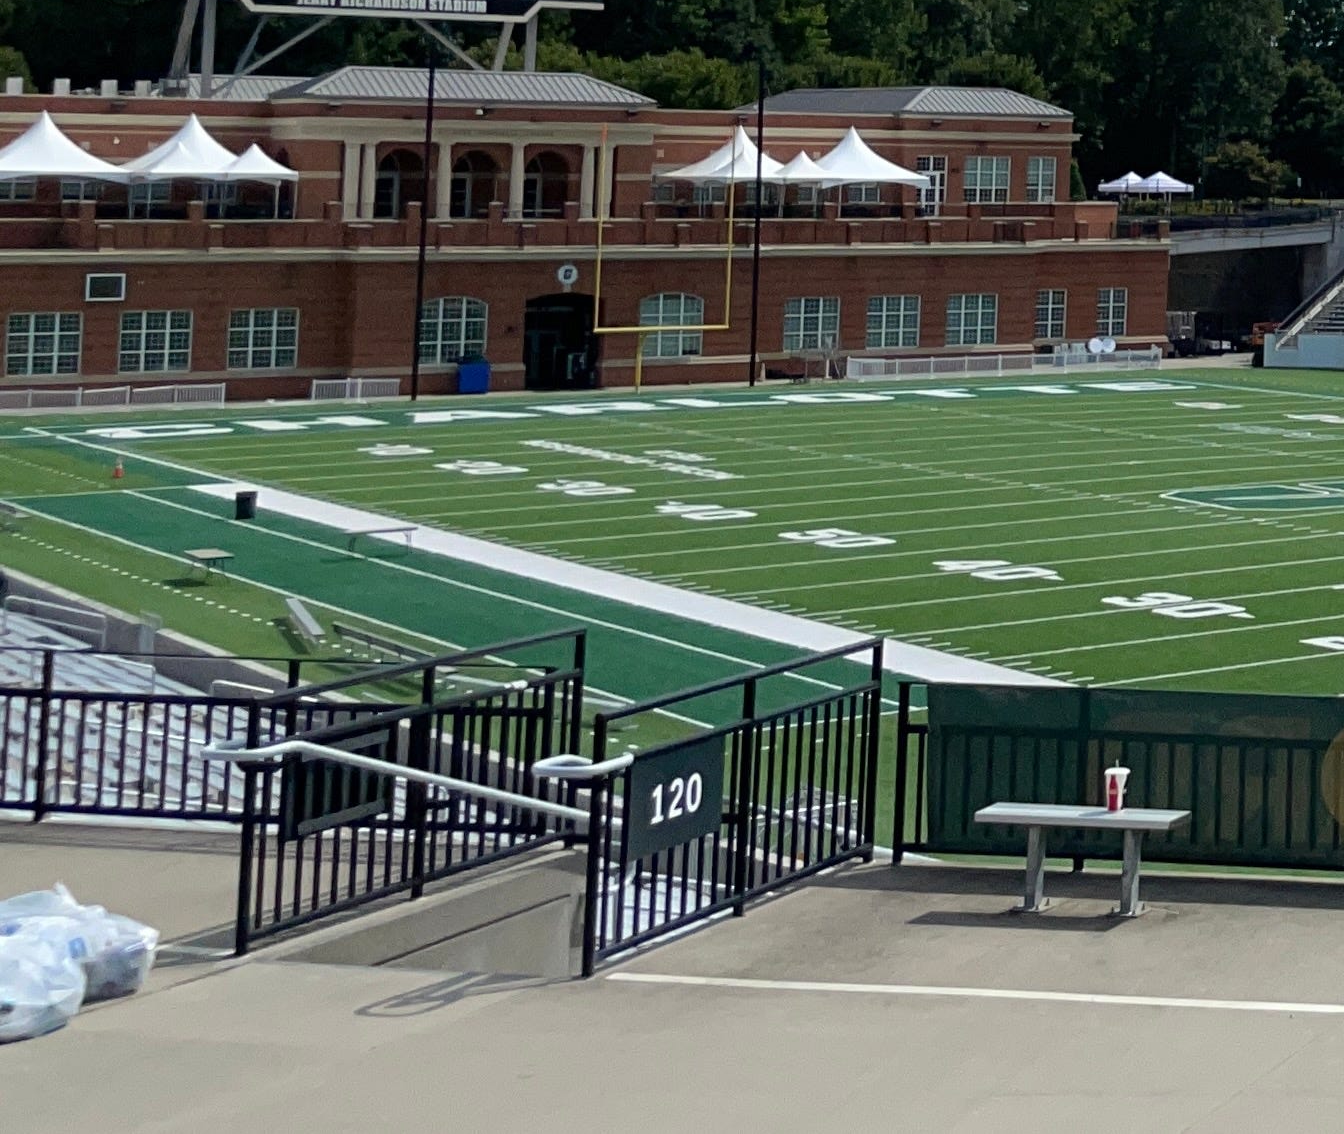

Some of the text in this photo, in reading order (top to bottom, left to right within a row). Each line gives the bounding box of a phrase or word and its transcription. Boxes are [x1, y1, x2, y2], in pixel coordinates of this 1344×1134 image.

[778, 527, 897, 548] 50
[932, 560, 1059, 581] 40
[1101, 592, 1247, 619] 30
[650, 772, 702, 825] 120
